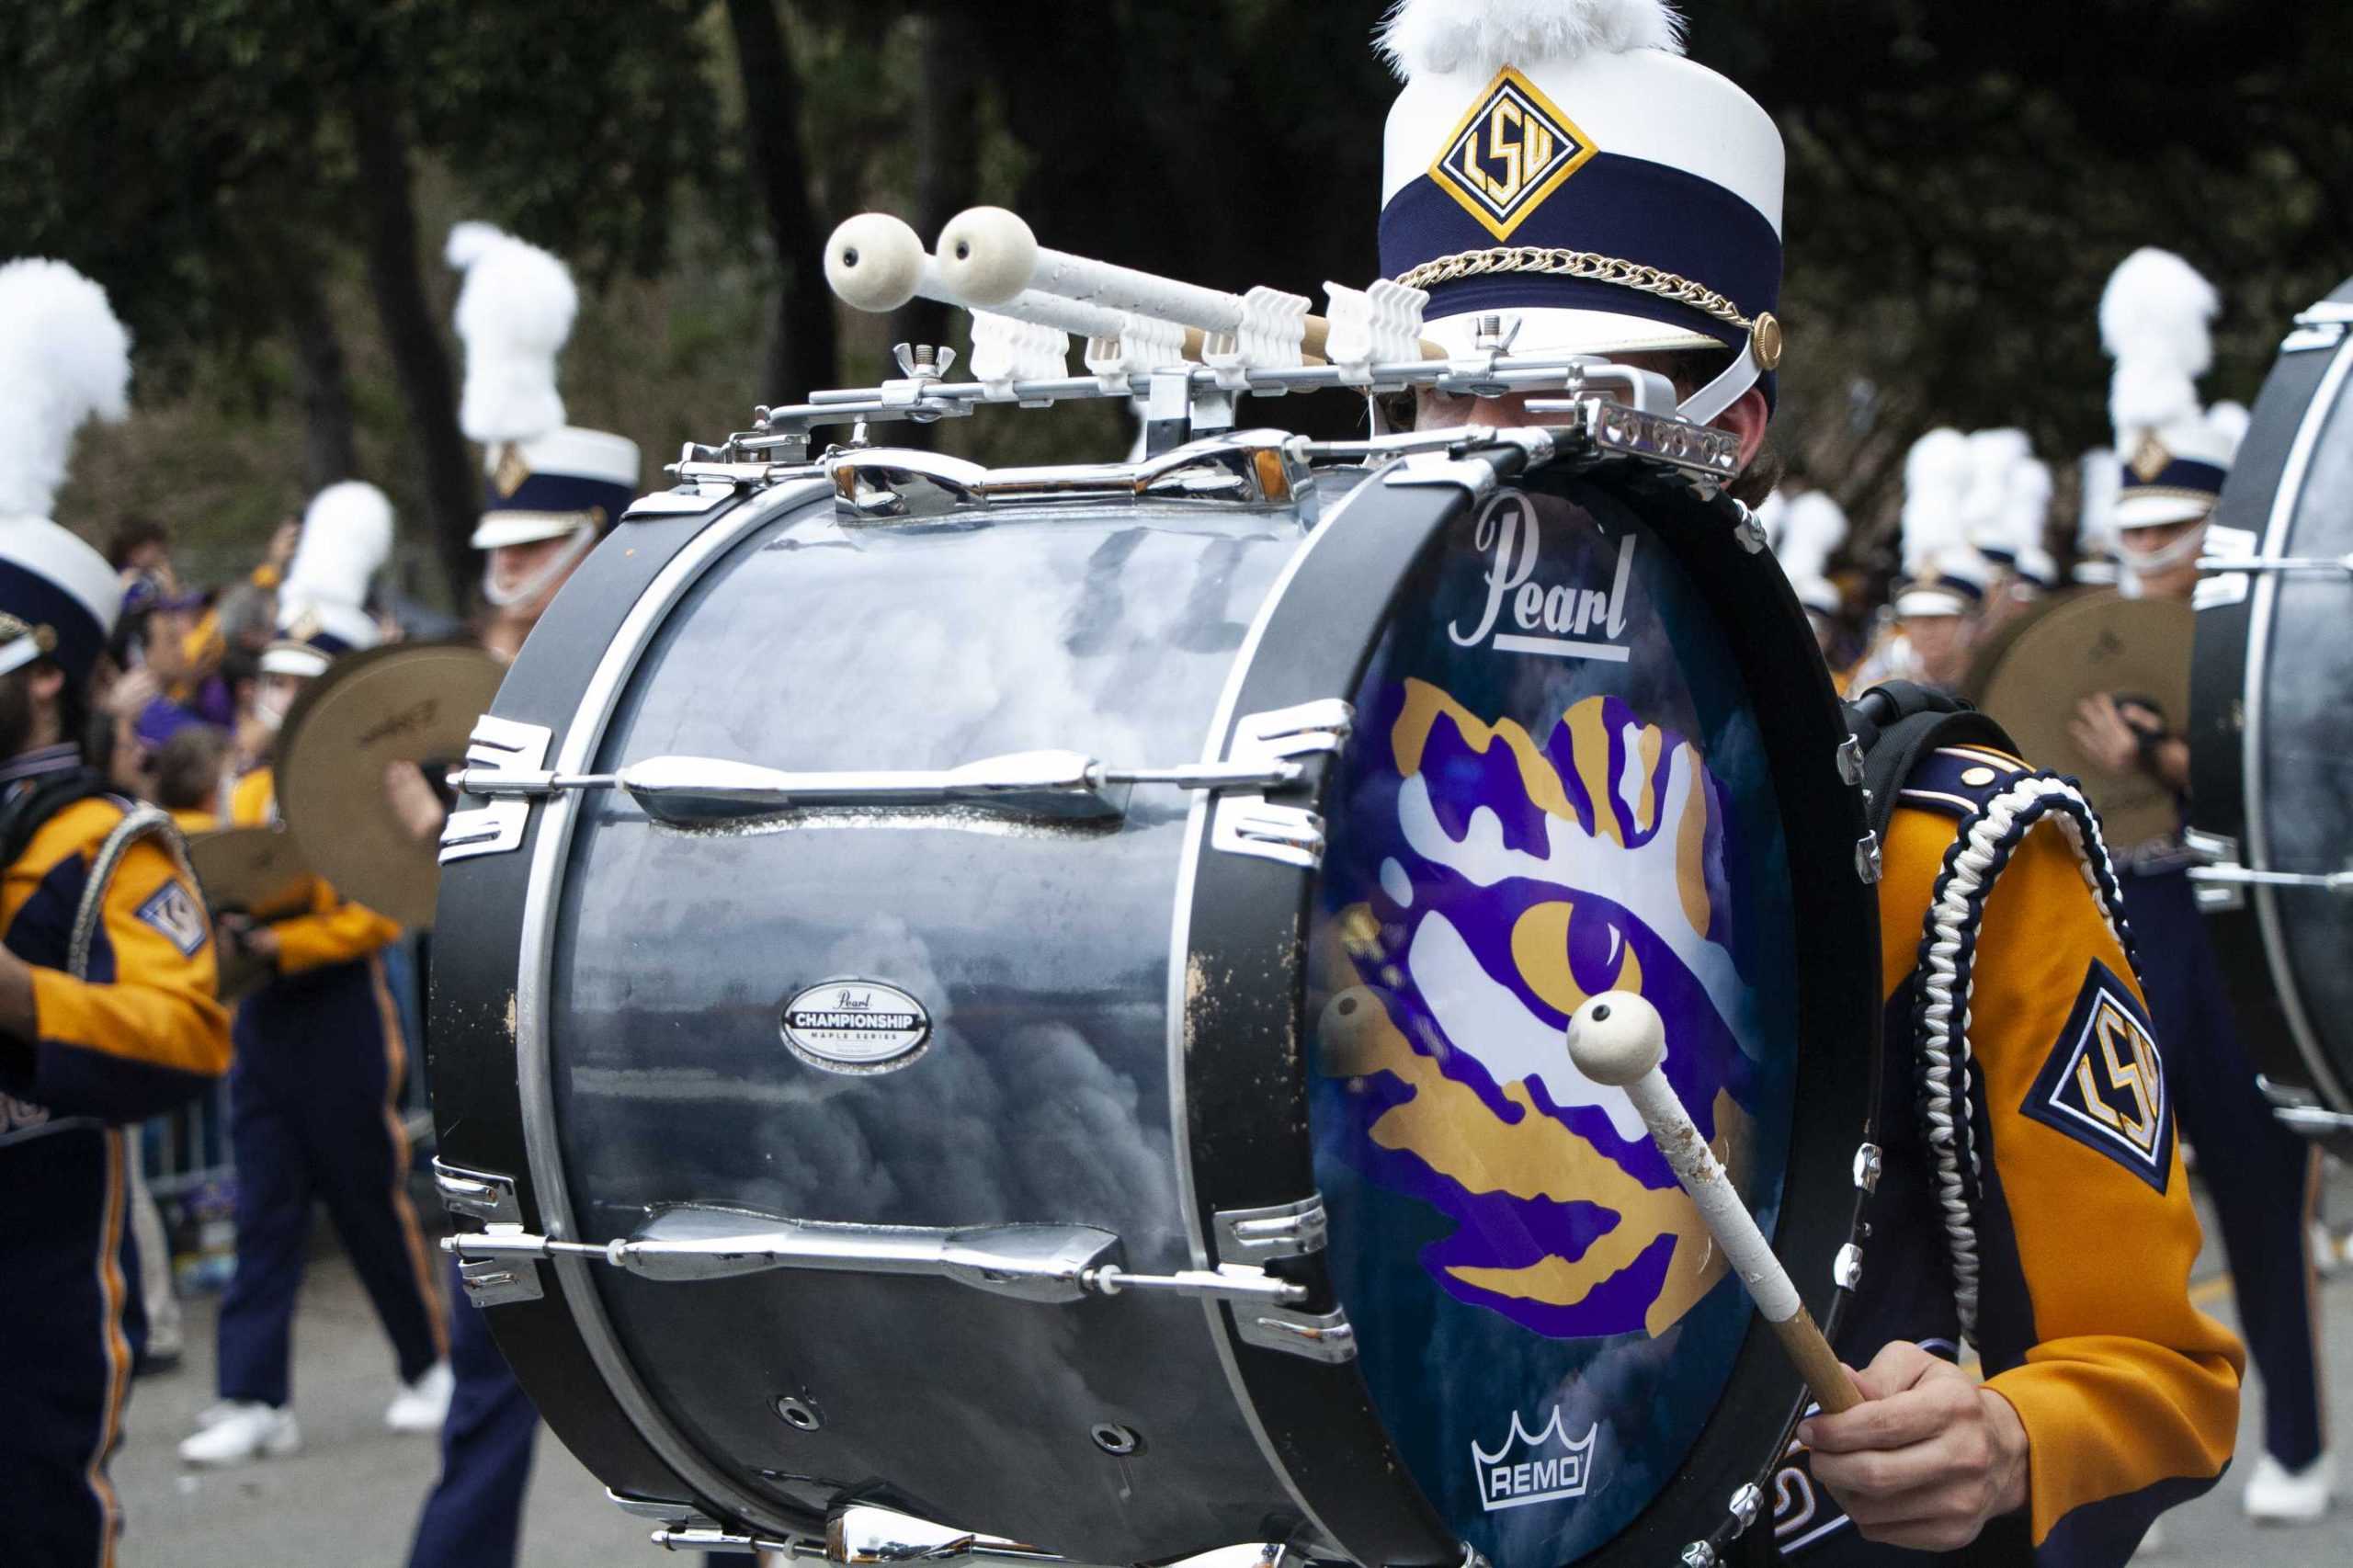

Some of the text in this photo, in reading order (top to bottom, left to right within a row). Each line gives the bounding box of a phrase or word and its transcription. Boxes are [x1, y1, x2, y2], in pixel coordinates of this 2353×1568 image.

[1463, 97, 1553, 207] LSU
[1448, 486, 1637, 647] Pearl
[795, 1013, 914, 1028] CHAMPIONSHIP
[833, 989, 871, 1010] Pearl
[2075, 1002, 2159, 1150] LSU
[1491, 1455, 1580, 1498] REMO
